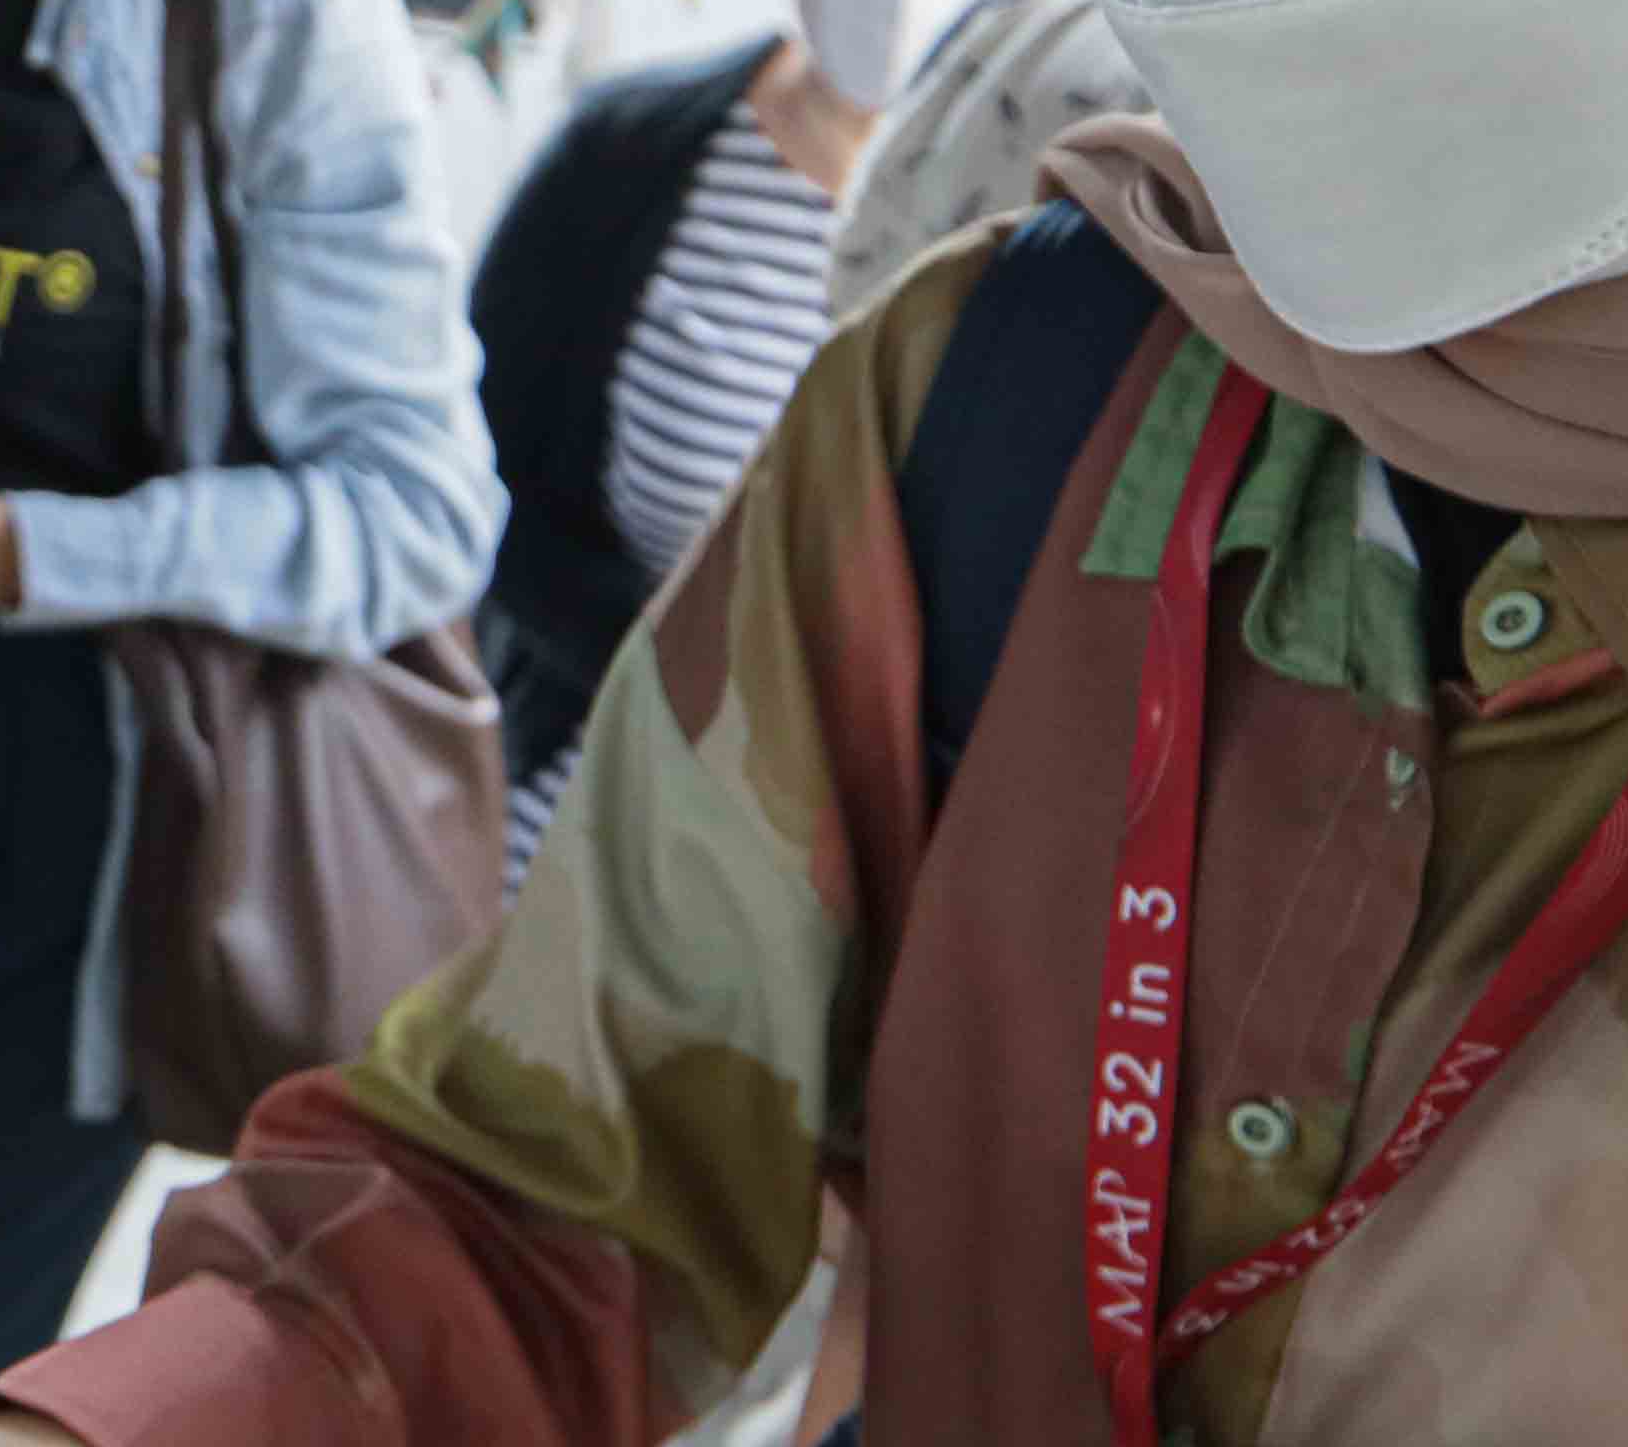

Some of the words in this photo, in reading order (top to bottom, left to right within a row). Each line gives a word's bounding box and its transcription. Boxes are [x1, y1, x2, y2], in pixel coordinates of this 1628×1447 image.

[1119, 883, 1178, 931] 3
[1109, 962, 1172, 1026] in
[1097, 1053, 1163, 1145] 32
[1093, 1167, 1152, 1336] MAP
